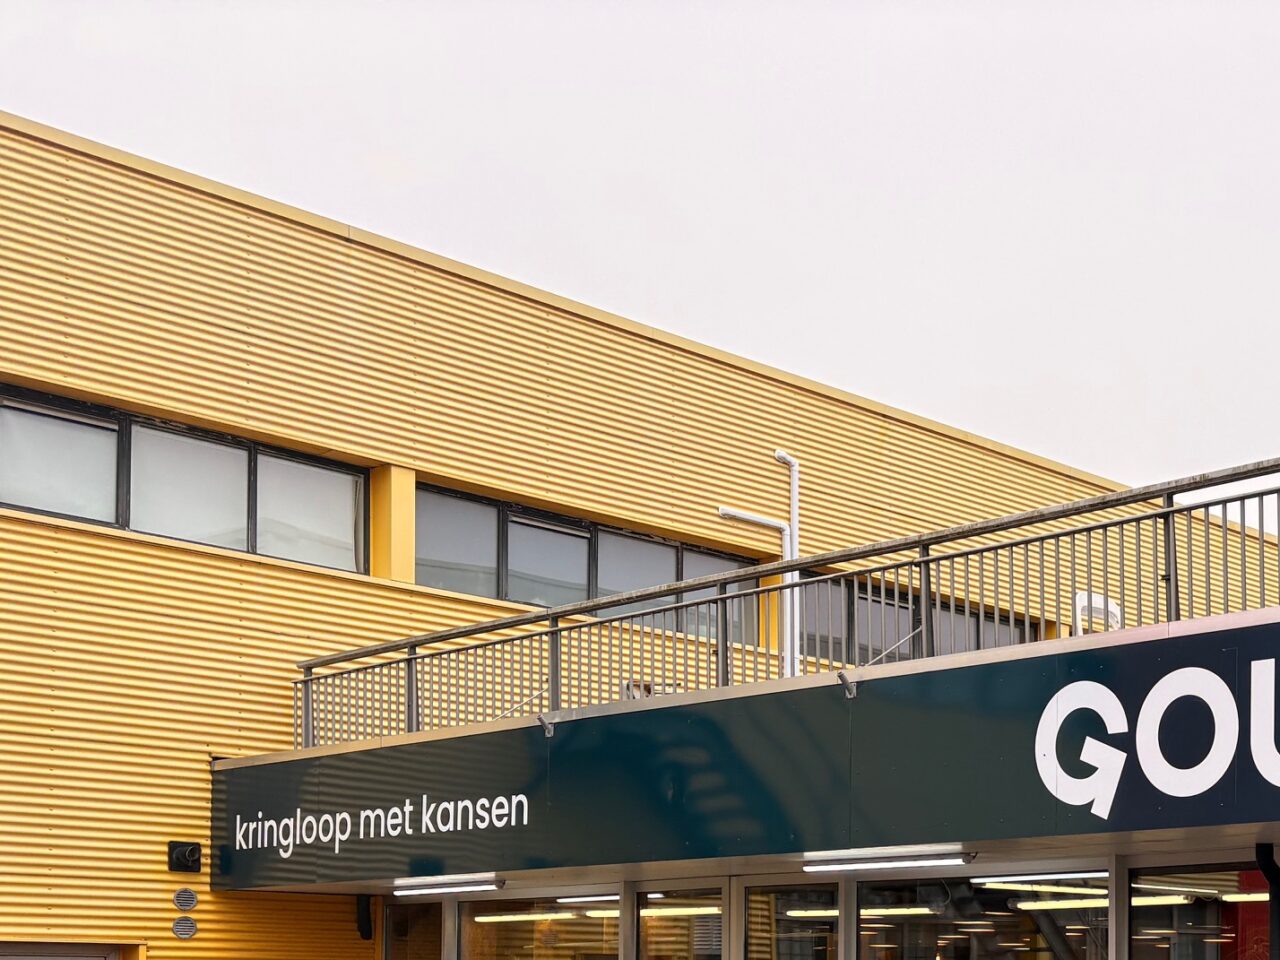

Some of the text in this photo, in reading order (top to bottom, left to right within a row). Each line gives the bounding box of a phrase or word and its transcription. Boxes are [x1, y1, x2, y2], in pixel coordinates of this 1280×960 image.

[236, 794, 529, 859] kringloop met kansen
